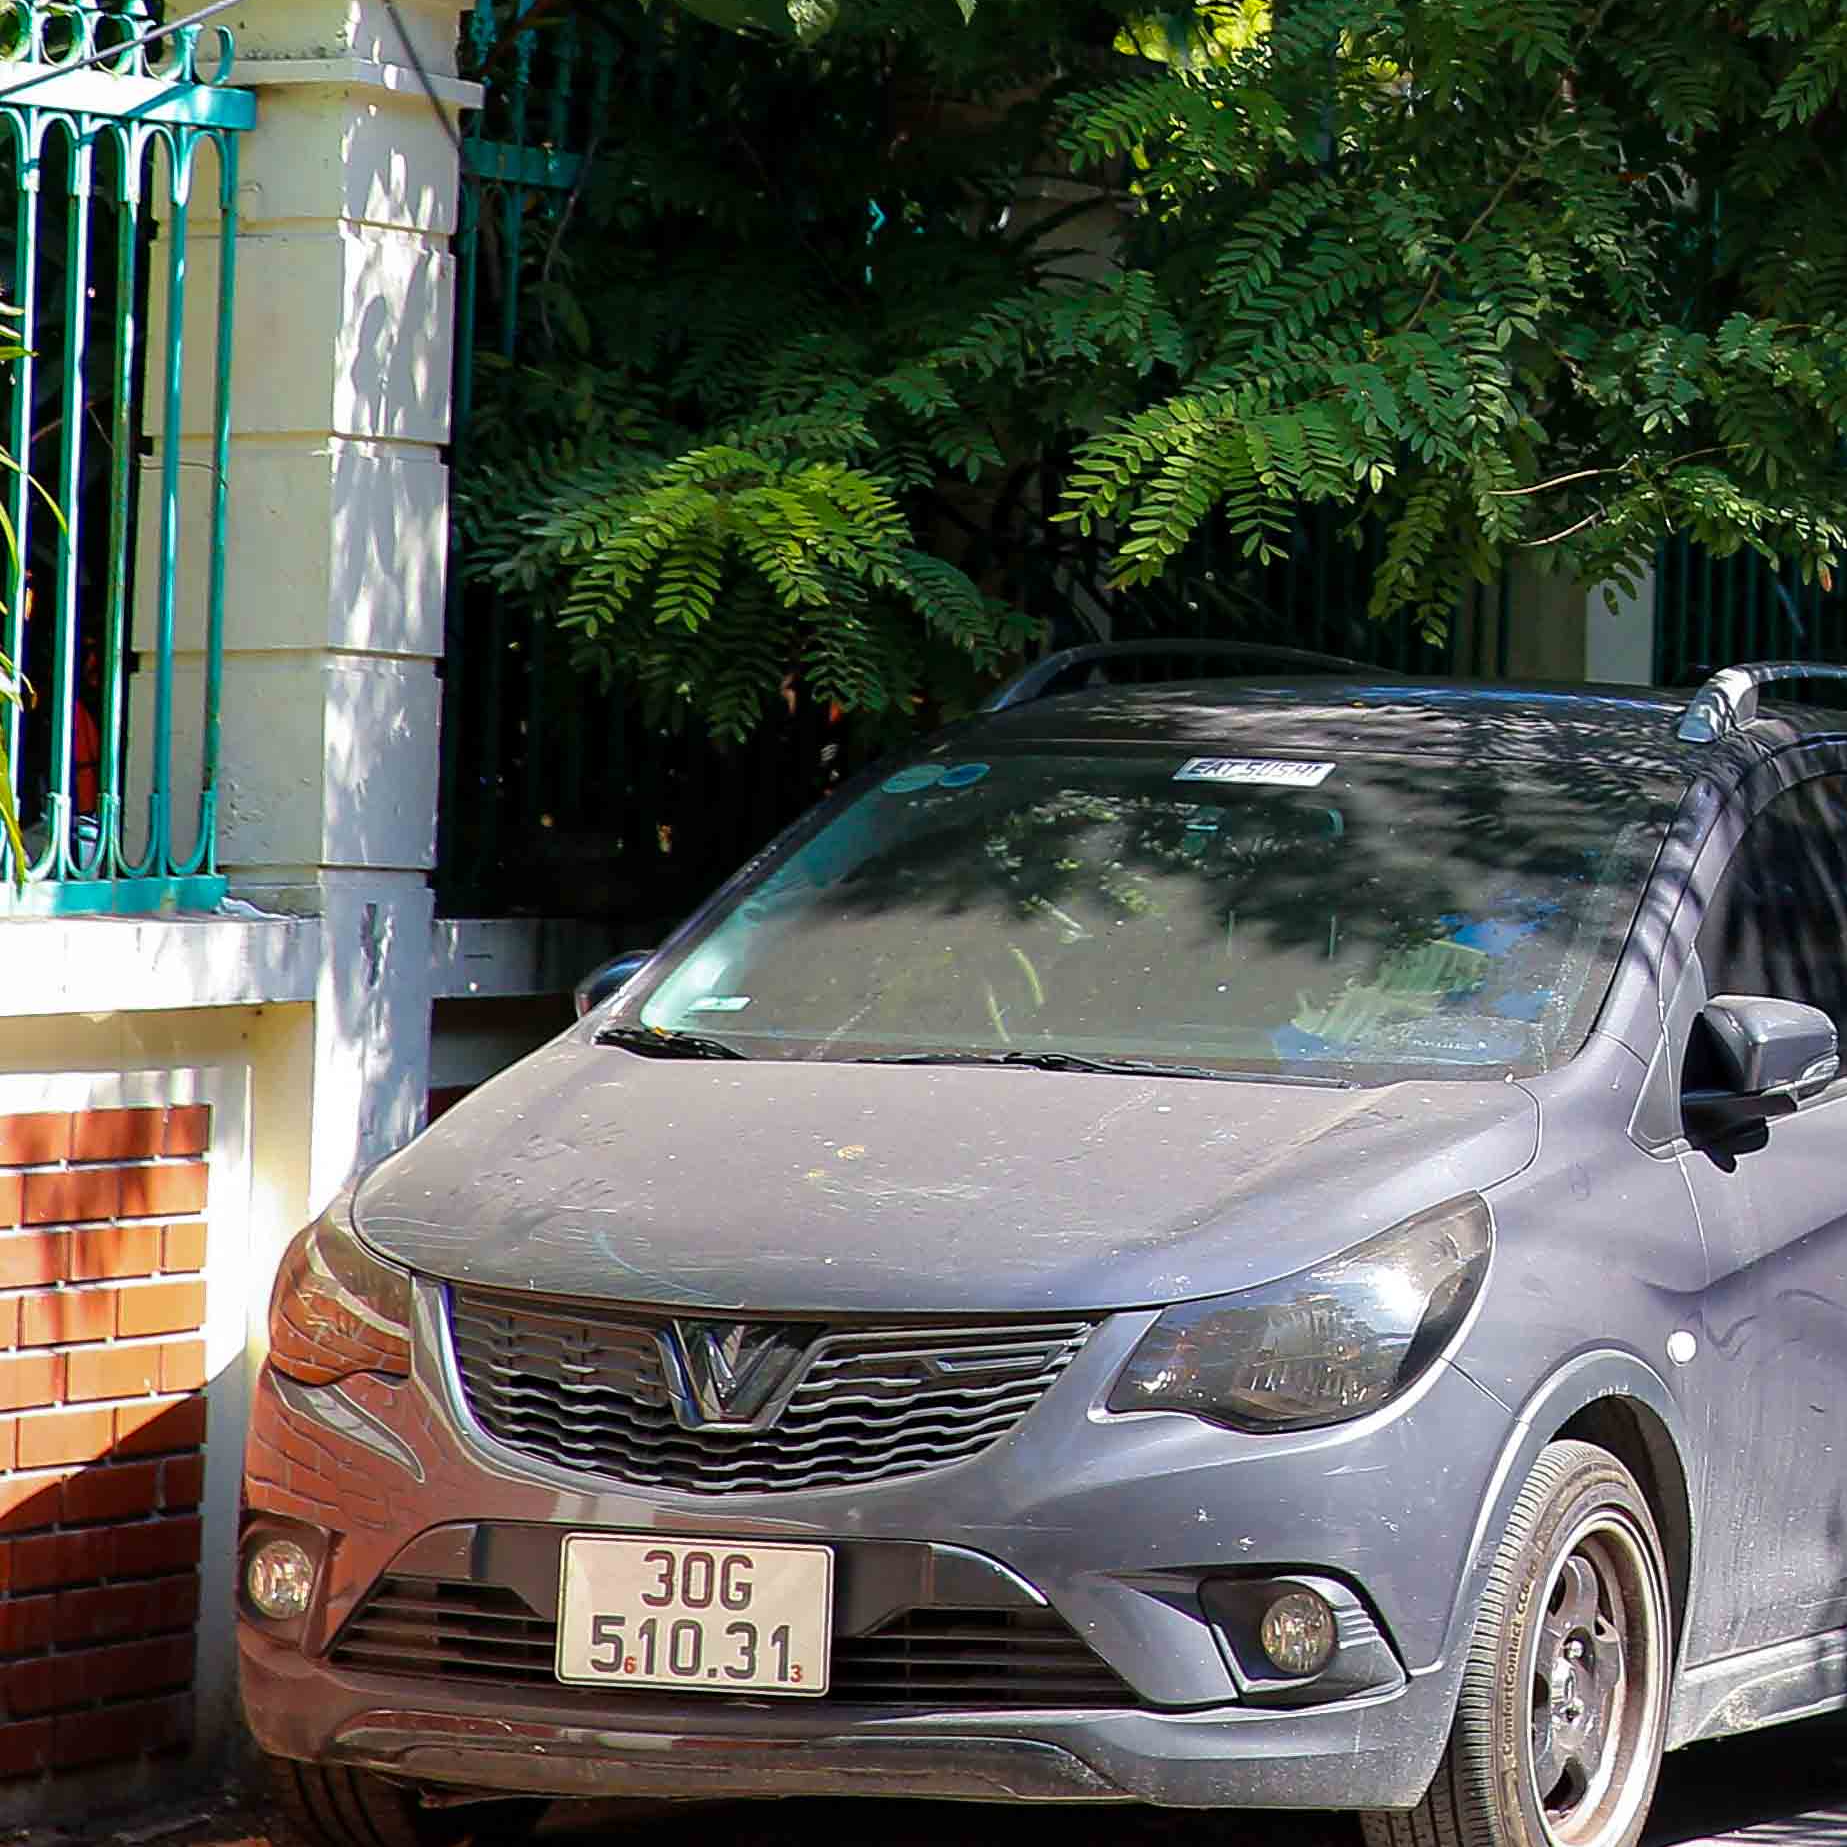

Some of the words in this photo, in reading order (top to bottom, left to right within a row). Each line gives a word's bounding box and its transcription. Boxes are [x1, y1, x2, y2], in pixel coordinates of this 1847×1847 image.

[1187, 759, 1237, 777] EAT
[642, 1549, 754, 1611] 30G
[590, 1614, 791, 1682] 510.31
[1503, 1620, 1522, 1755] ComfortContact
